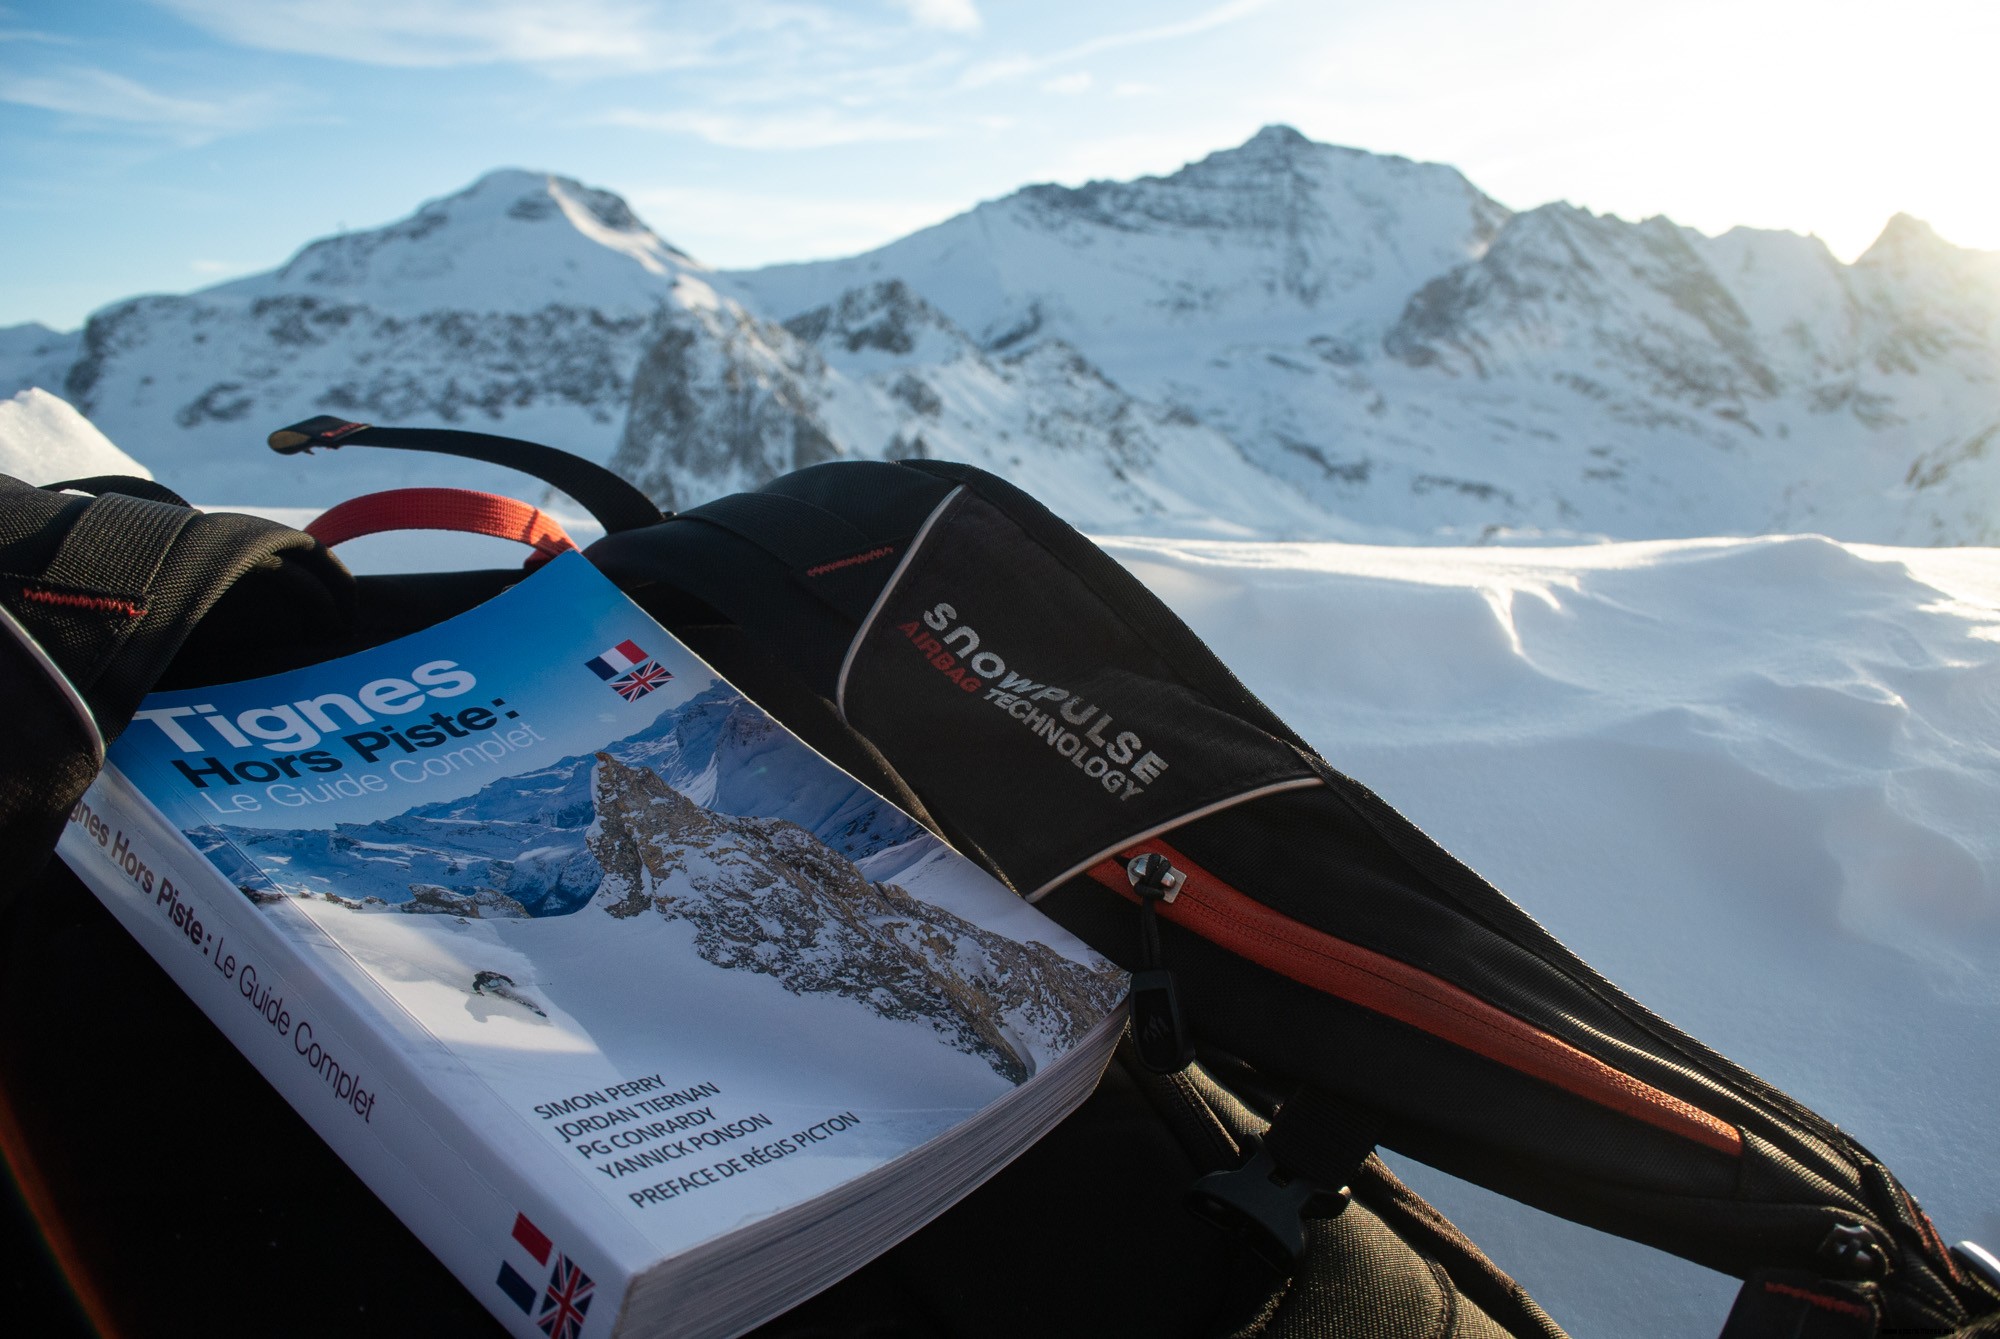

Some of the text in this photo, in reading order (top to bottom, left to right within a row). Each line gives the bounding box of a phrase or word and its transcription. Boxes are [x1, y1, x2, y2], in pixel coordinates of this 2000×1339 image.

[132, 660, 477, 753] Tignes
[172, 698, 520, 787] Hors Piste:
[899, 620, 1144, 801] AIRBAG TECHNOLOGY
[201, 722, 545, 814] Le Guide Complet
[69, 800, 110, 847] gnes
[111, 830, 155, 894] Hors
[213, 937, 236, 979] Le
[239, 964, 291, 1036] Guide
[295, 1021, 375, 1123] Complet
[533, 1074, 667, 1120] SIMON PERRY
[554, 1081, 721, 1143] JORDAN TIERNAN
[576, 1107, 717, 1160] PG CONRARDY
[596, 1113, 773, 1180] YANNICK PONSON
[629, 1111, 861, 1209] PREFACE DE RÉGIS PICTON
